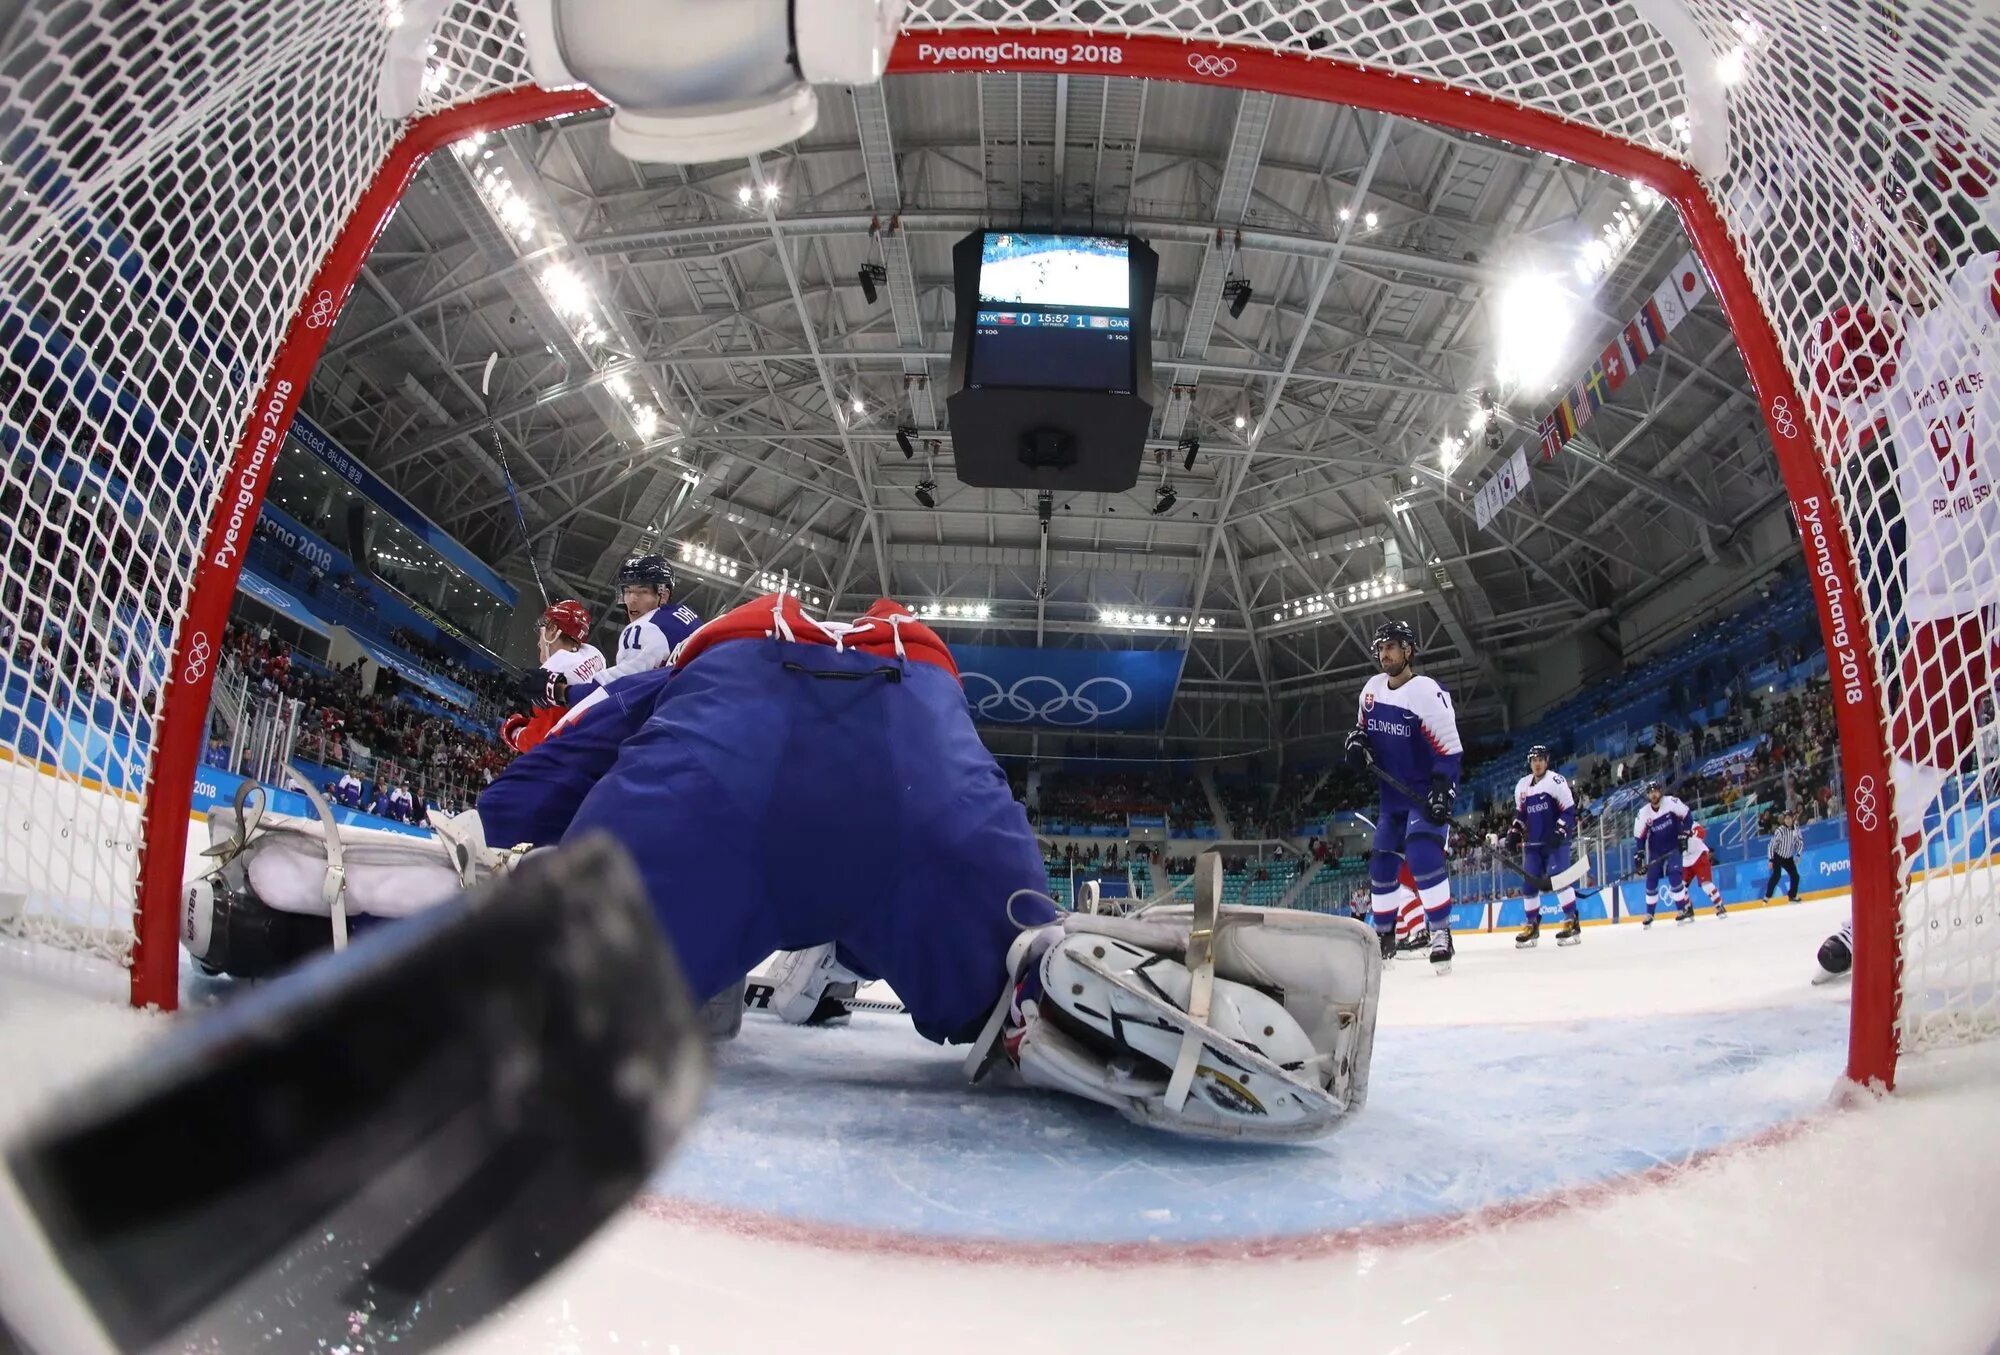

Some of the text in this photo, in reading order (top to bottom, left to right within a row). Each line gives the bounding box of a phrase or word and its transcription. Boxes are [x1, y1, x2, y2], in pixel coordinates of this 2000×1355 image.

[918, 43, 1123, 65] PyeongChang 2018
[980, 313, 998, 322] SVK
[1021, 313, 1031, 325] 0
[1038, 314, 1069, 324] 15:52
[1076, 315, 1085, 328] 1
[1109, 319, 1129, 328] OAR
[290, 419, 326, 456] nected.
[213, 429, 277, 569] PyeongChang
[265, 379, 294, 427] 2018
[297, 535, 332, 572] 2018
[1803, 495, 1863, 705] PyeongChang 2018
[193, 780, 217, 799] 2018
